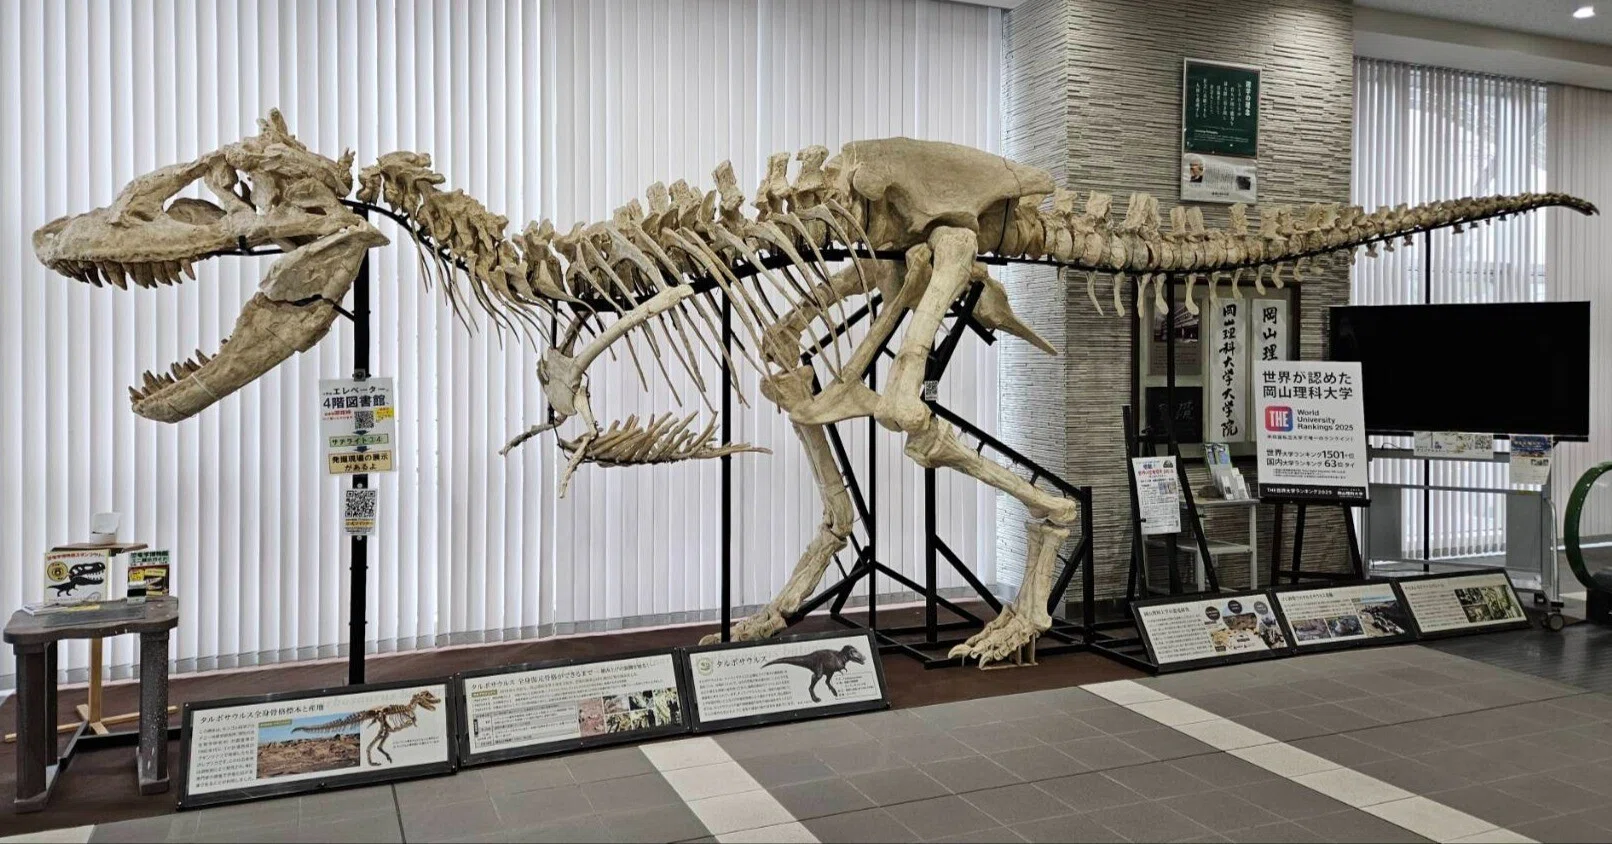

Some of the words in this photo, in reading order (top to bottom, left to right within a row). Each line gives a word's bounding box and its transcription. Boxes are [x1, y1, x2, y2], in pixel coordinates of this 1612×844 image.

[1219, 303, 1238, 438] 岡山理科大学大学院
[1262, 370, 1352, 385] 世界が認めた
[1263, 385, 1353, 400] 岡山理科大学
[1269, 410, 1290, 428] THE
[1297, 416, 1336, 424] University
[344, 463, 376, 472] があるよ
[717, 655, 767, 668] タルボサウルス
[471, 680, 515, 690] タルボサウルス
[200, 703, 325, 725] タルボサウルス全身骨格標本と産地
